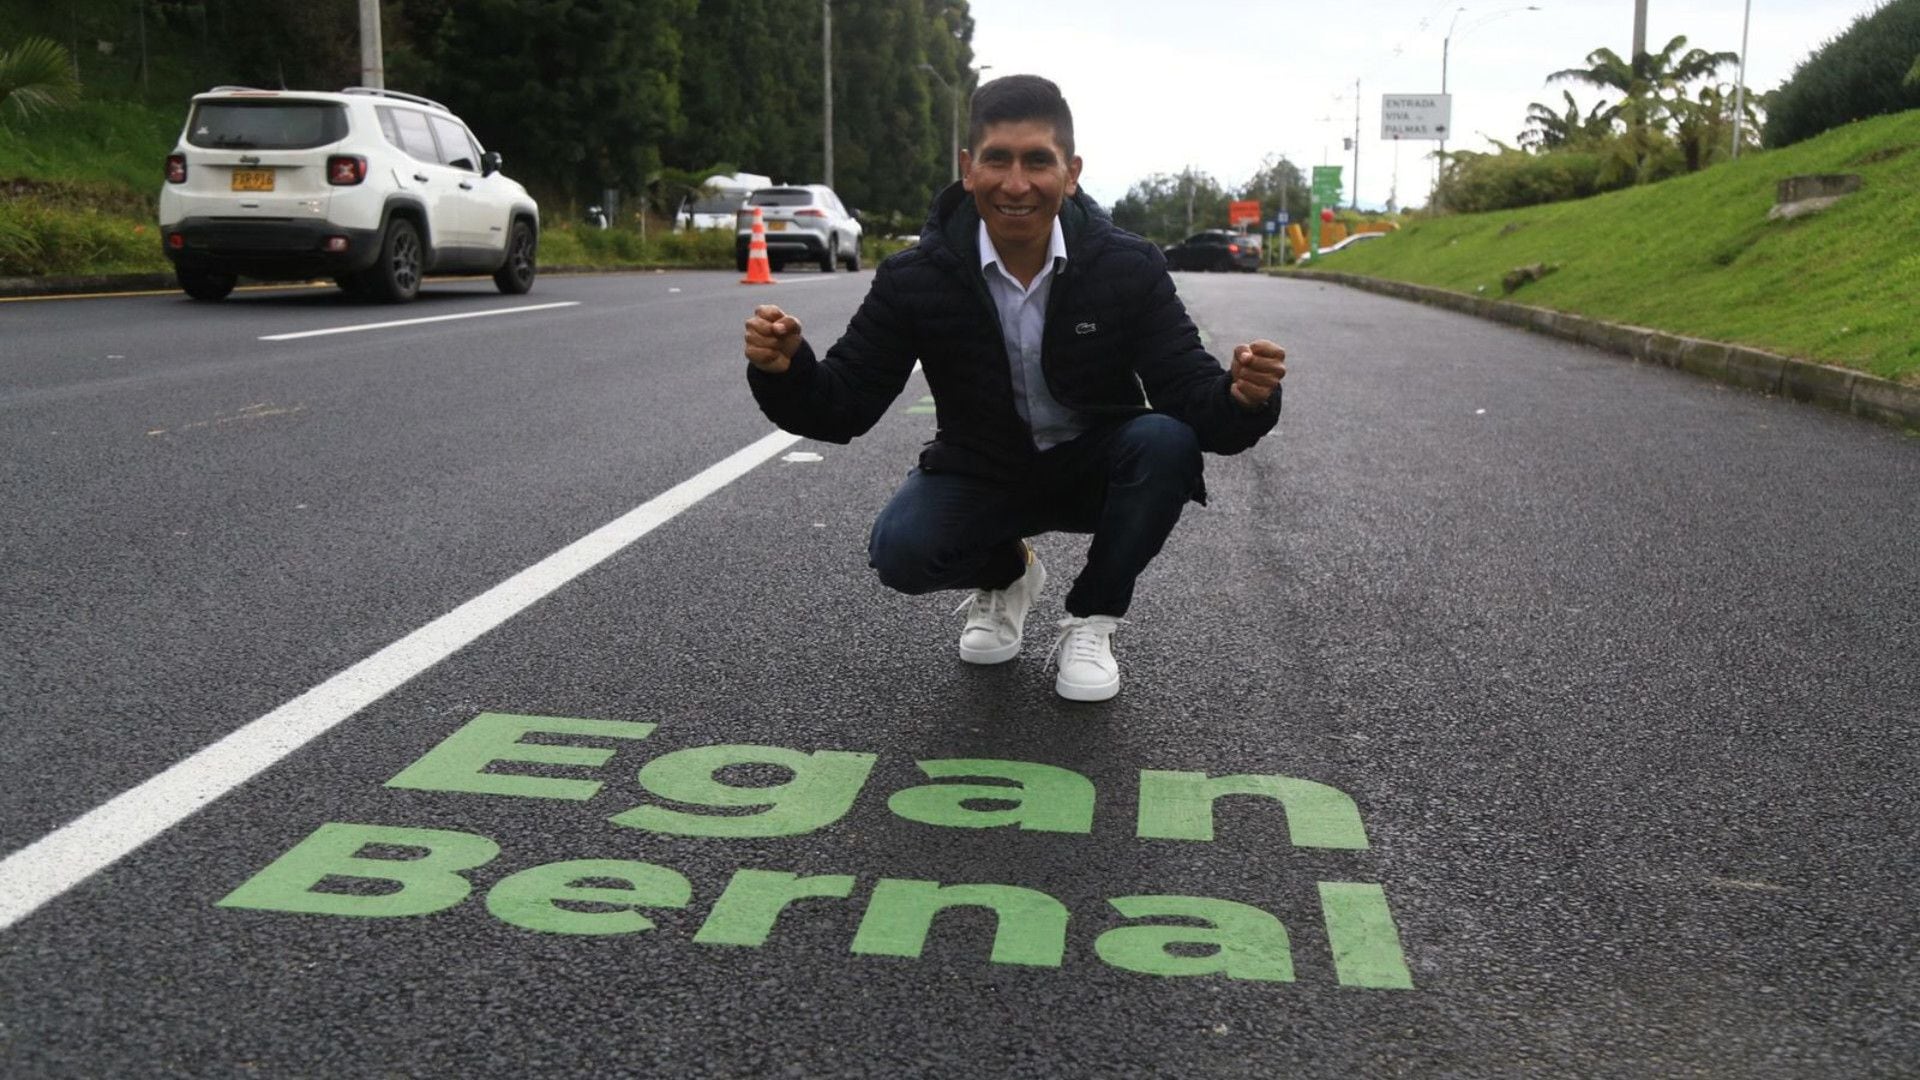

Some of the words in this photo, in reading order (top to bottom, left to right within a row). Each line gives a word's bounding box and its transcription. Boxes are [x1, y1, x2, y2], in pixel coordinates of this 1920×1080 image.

[1385, 98, 1436, 109] ENTRADA
[1385, 111, 1410, 121] VIVA
[1384, 124, 1428, 134] PALMAS
[384, 712, 1371, 850] Egan
[215, 822, 1416, 991] Bernal
